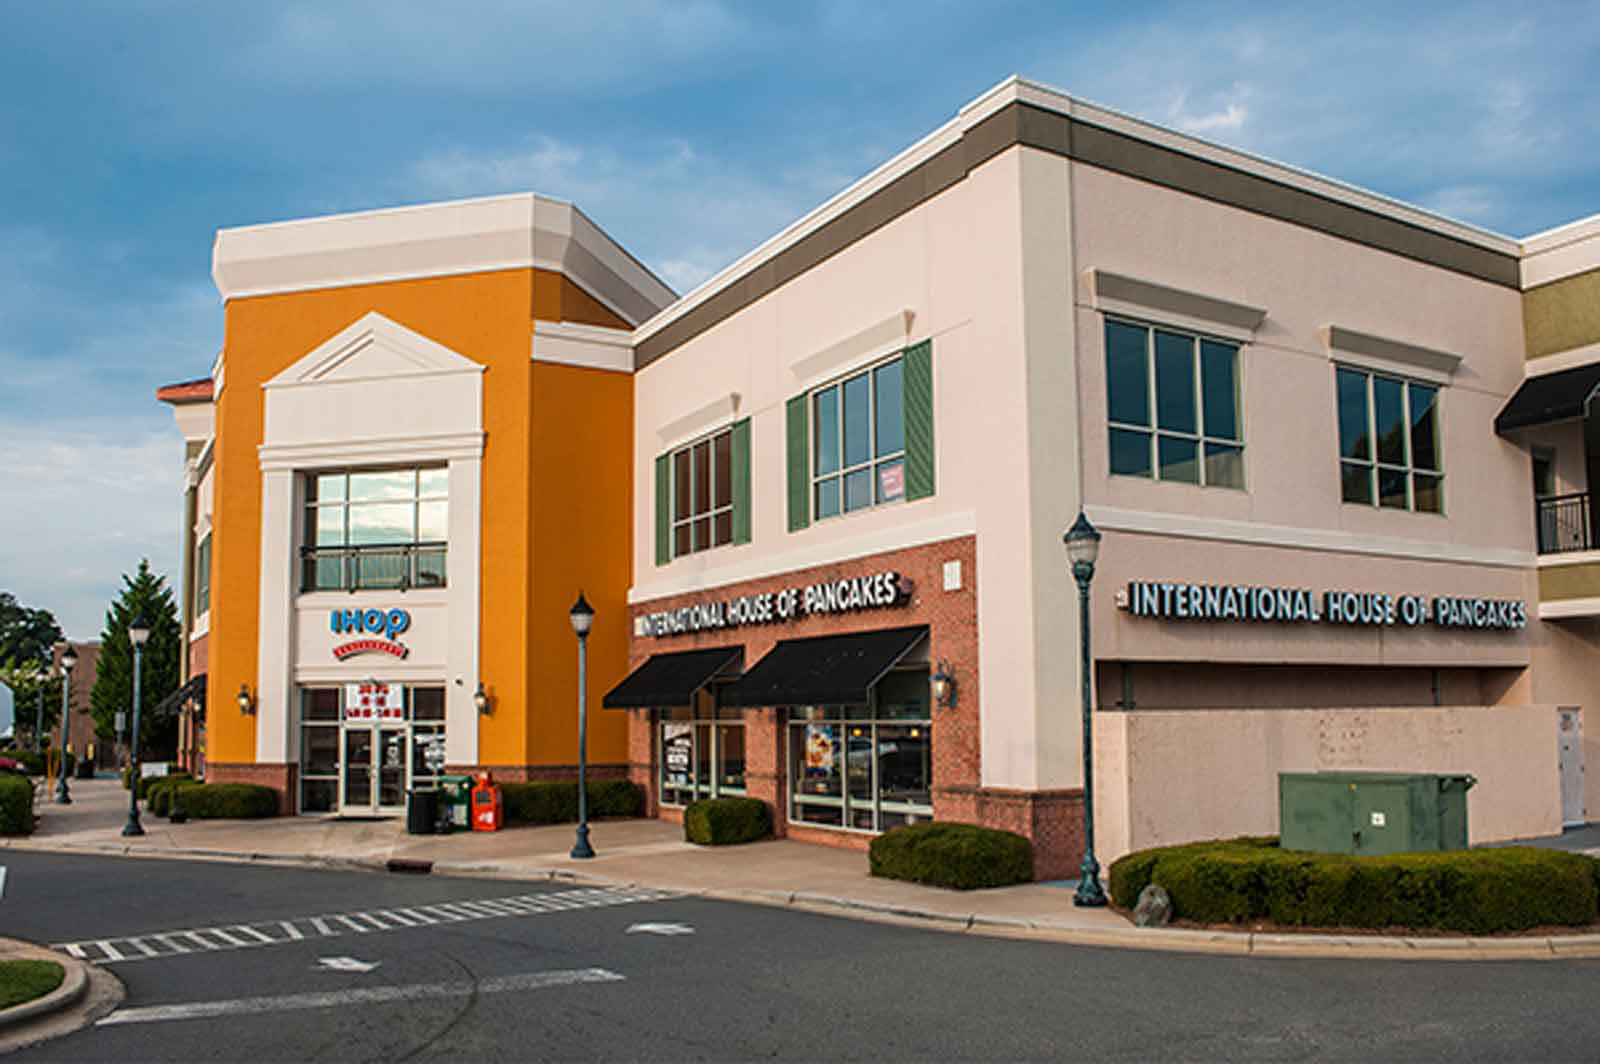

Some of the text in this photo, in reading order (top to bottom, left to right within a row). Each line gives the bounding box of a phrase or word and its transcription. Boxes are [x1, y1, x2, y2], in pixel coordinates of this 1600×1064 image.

[634, 572, 896, 635] INTERNATIONAL HOUSE OF PANCAKES
[1130, 582, 1527, 628] INTERNATIONAL HOUSE OF PANCAKES
